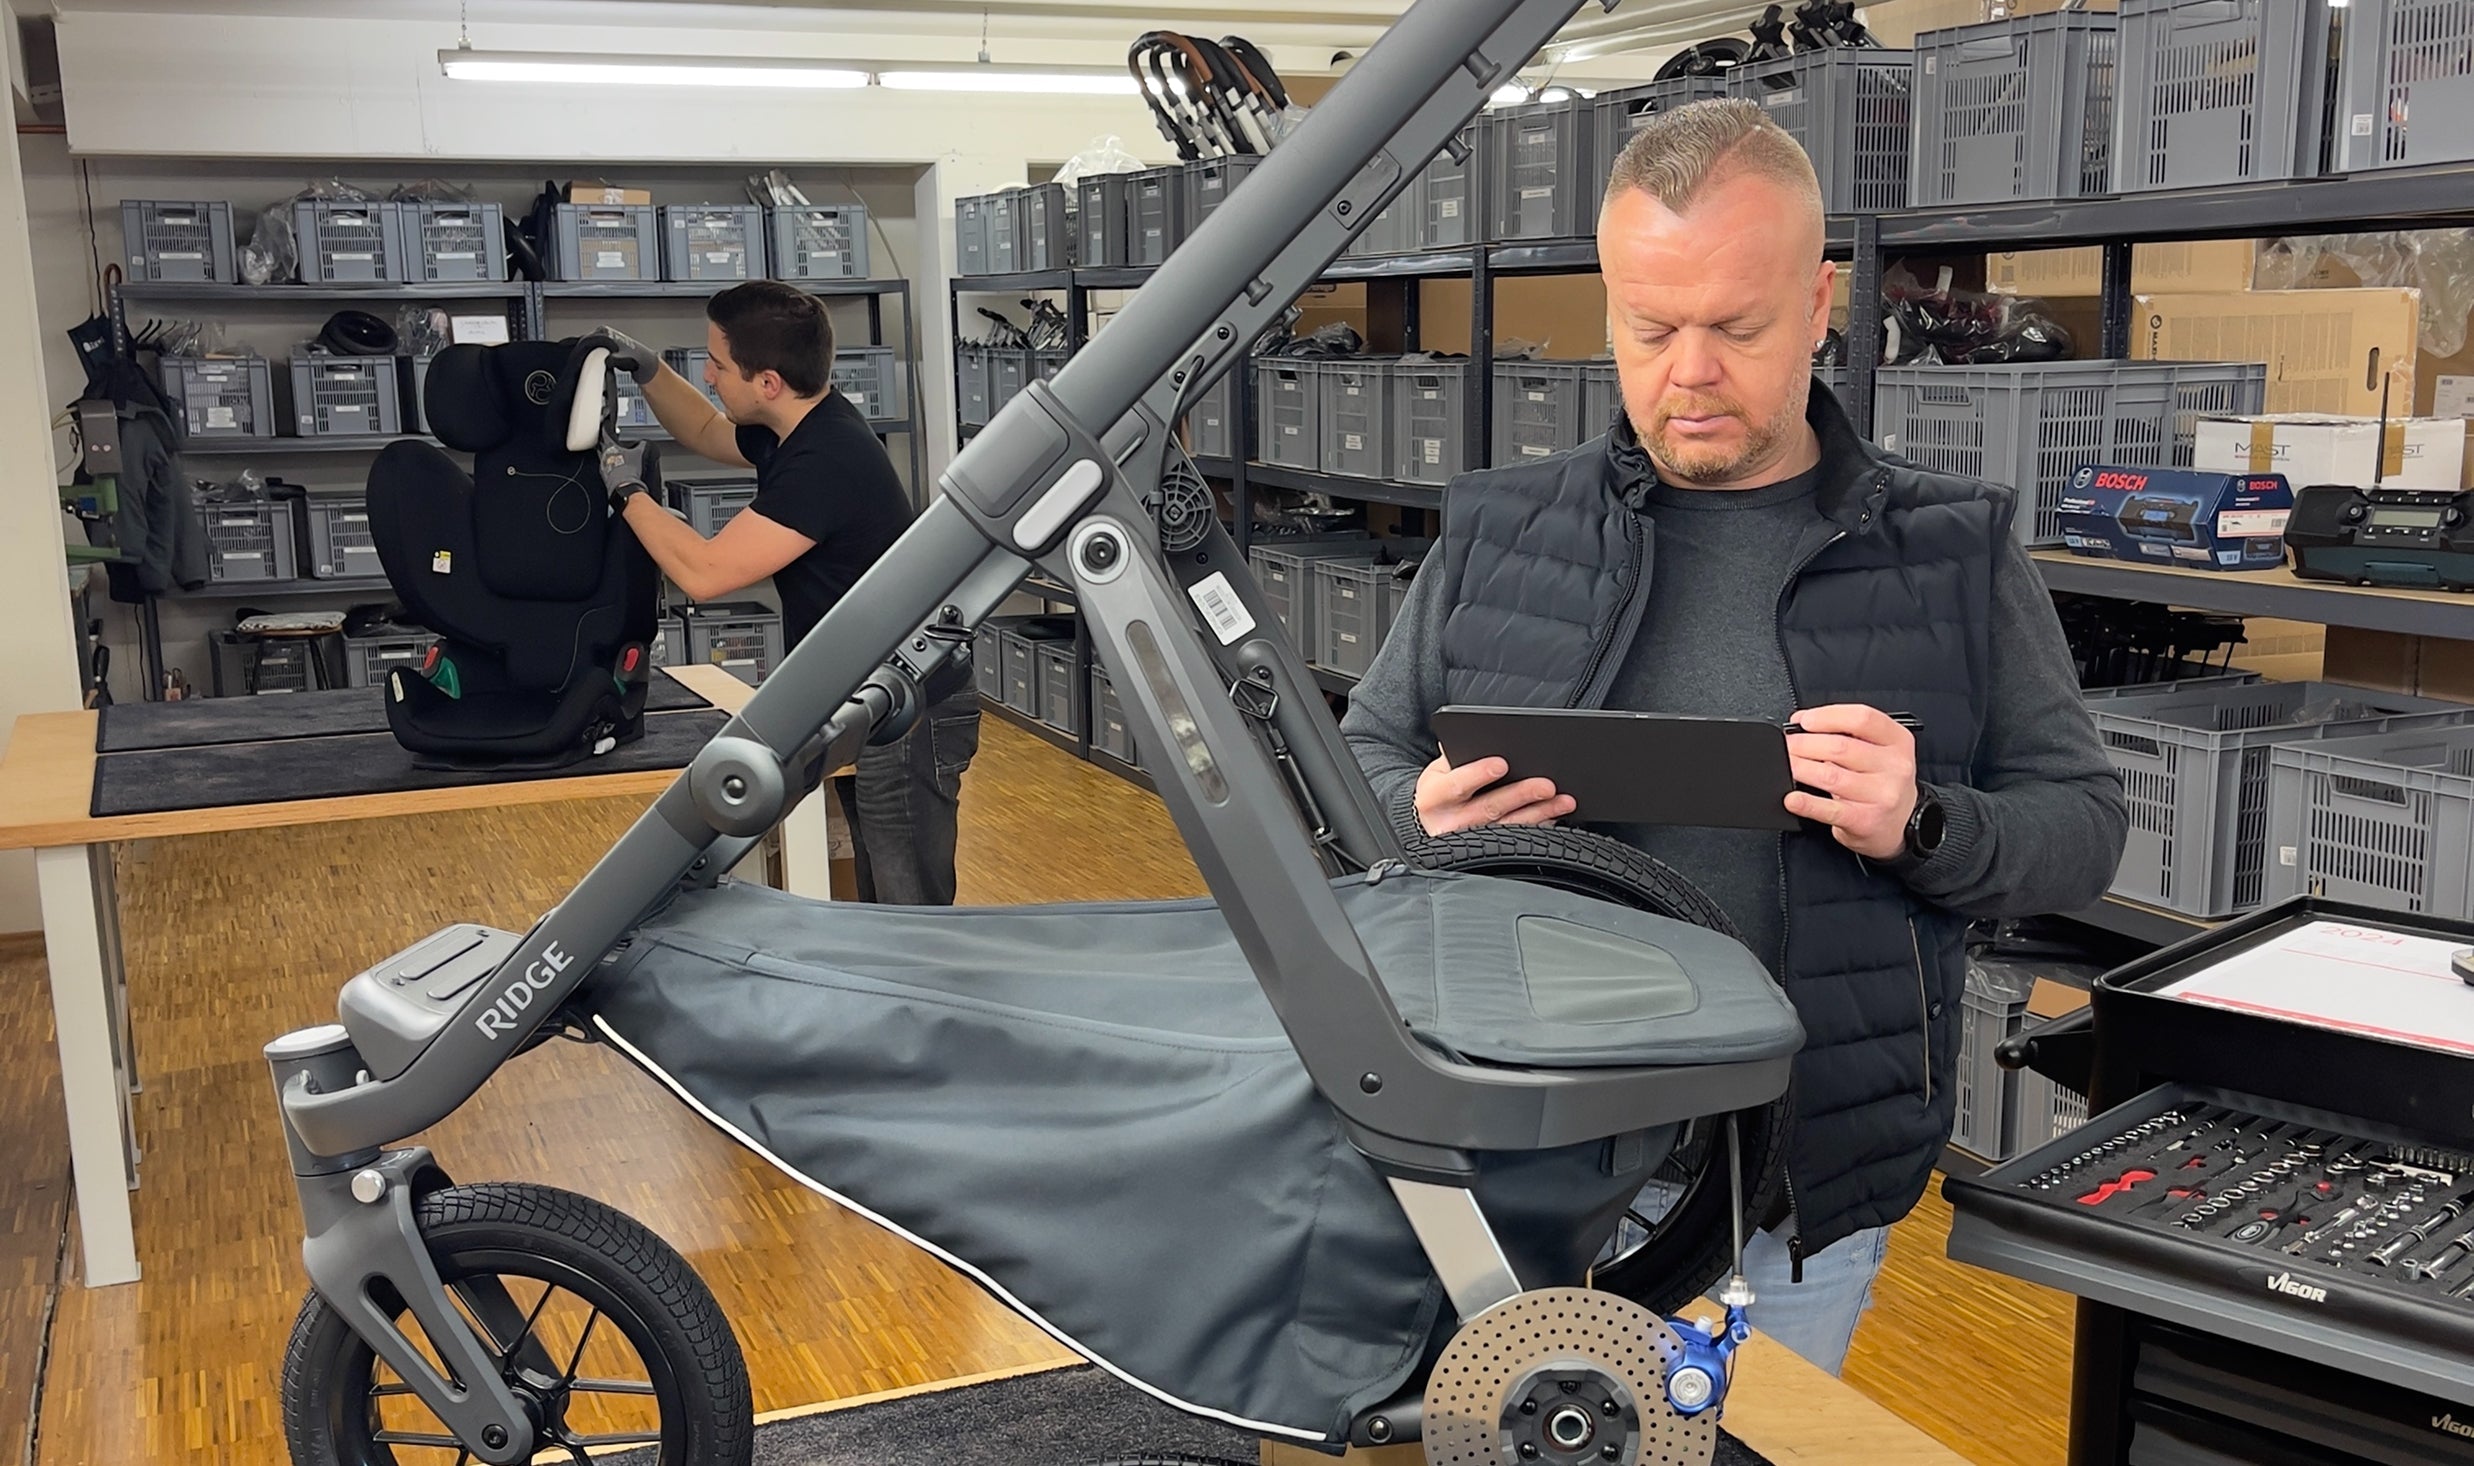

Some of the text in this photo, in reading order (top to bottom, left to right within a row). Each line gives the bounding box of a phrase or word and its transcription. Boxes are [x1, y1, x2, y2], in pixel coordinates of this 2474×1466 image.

[2095, 472, 2148, 491] BOSCH
[2249, 481, 2278, 491] BOSCH
[2320, 926, 2404, 946] 2024
[475, 940, 574, 1040] RIDGE
[2268, 1272, 2327, 1302] VIGOR
